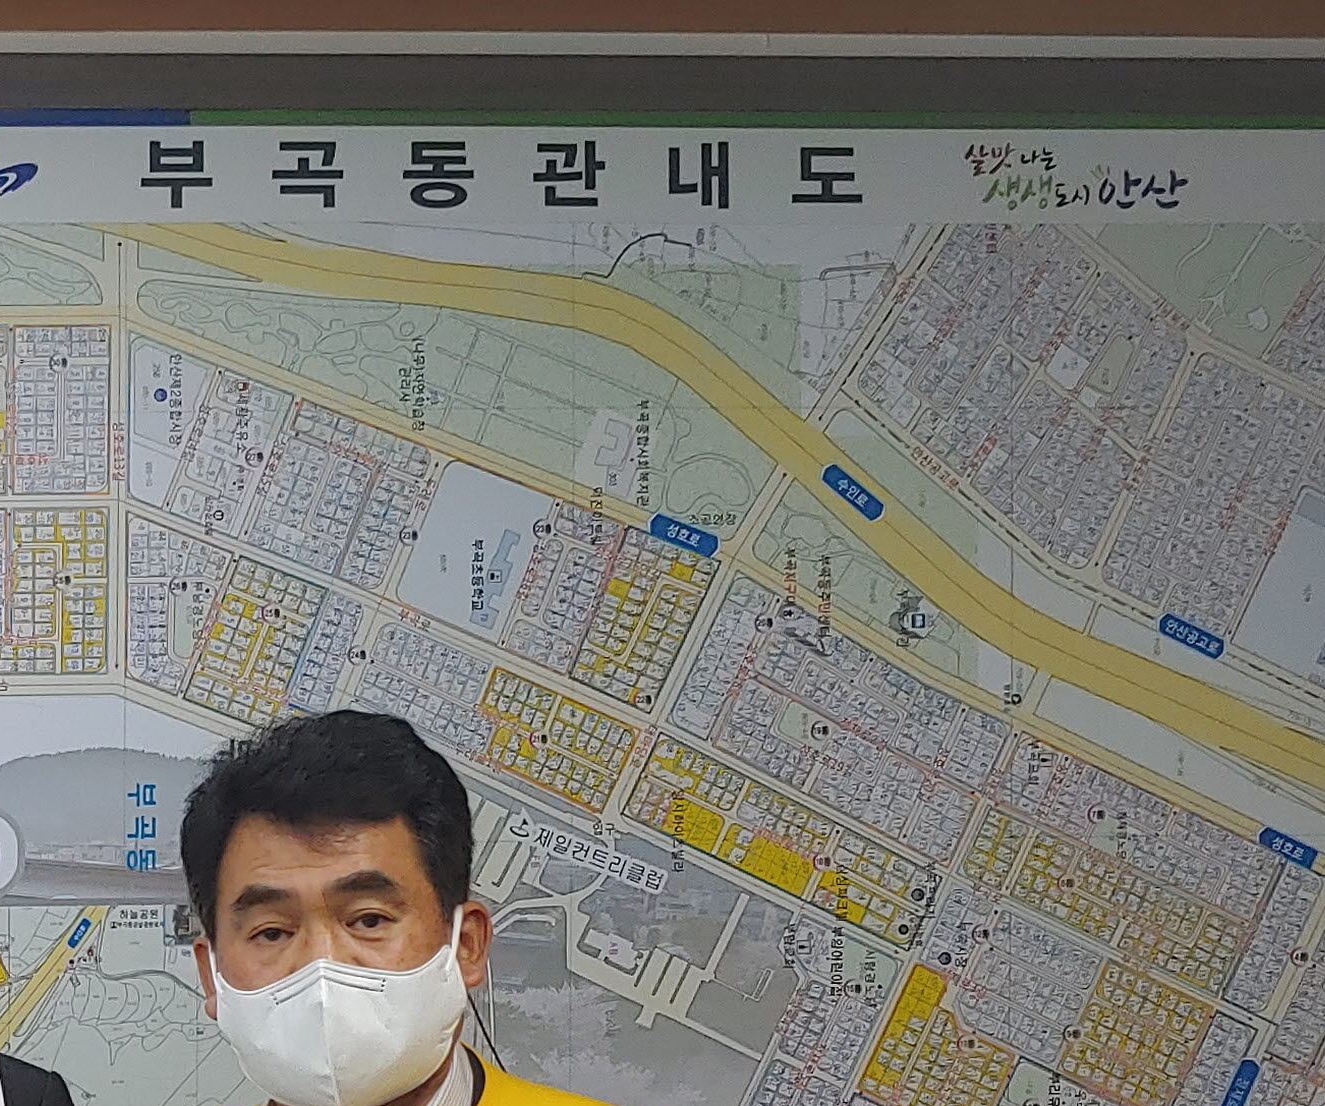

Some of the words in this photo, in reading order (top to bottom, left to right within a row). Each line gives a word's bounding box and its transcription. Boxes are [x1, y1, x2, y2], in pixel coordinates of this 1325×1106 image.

[965, 142, 1016, 176] 살맛
[1021, 147, 1057, 171] 나는
[1099, 169, 1188, 209] 안산
[127, 781, 158, 872] 부곡동
[534, 828, 664, 891] 제일컨트리클럽
